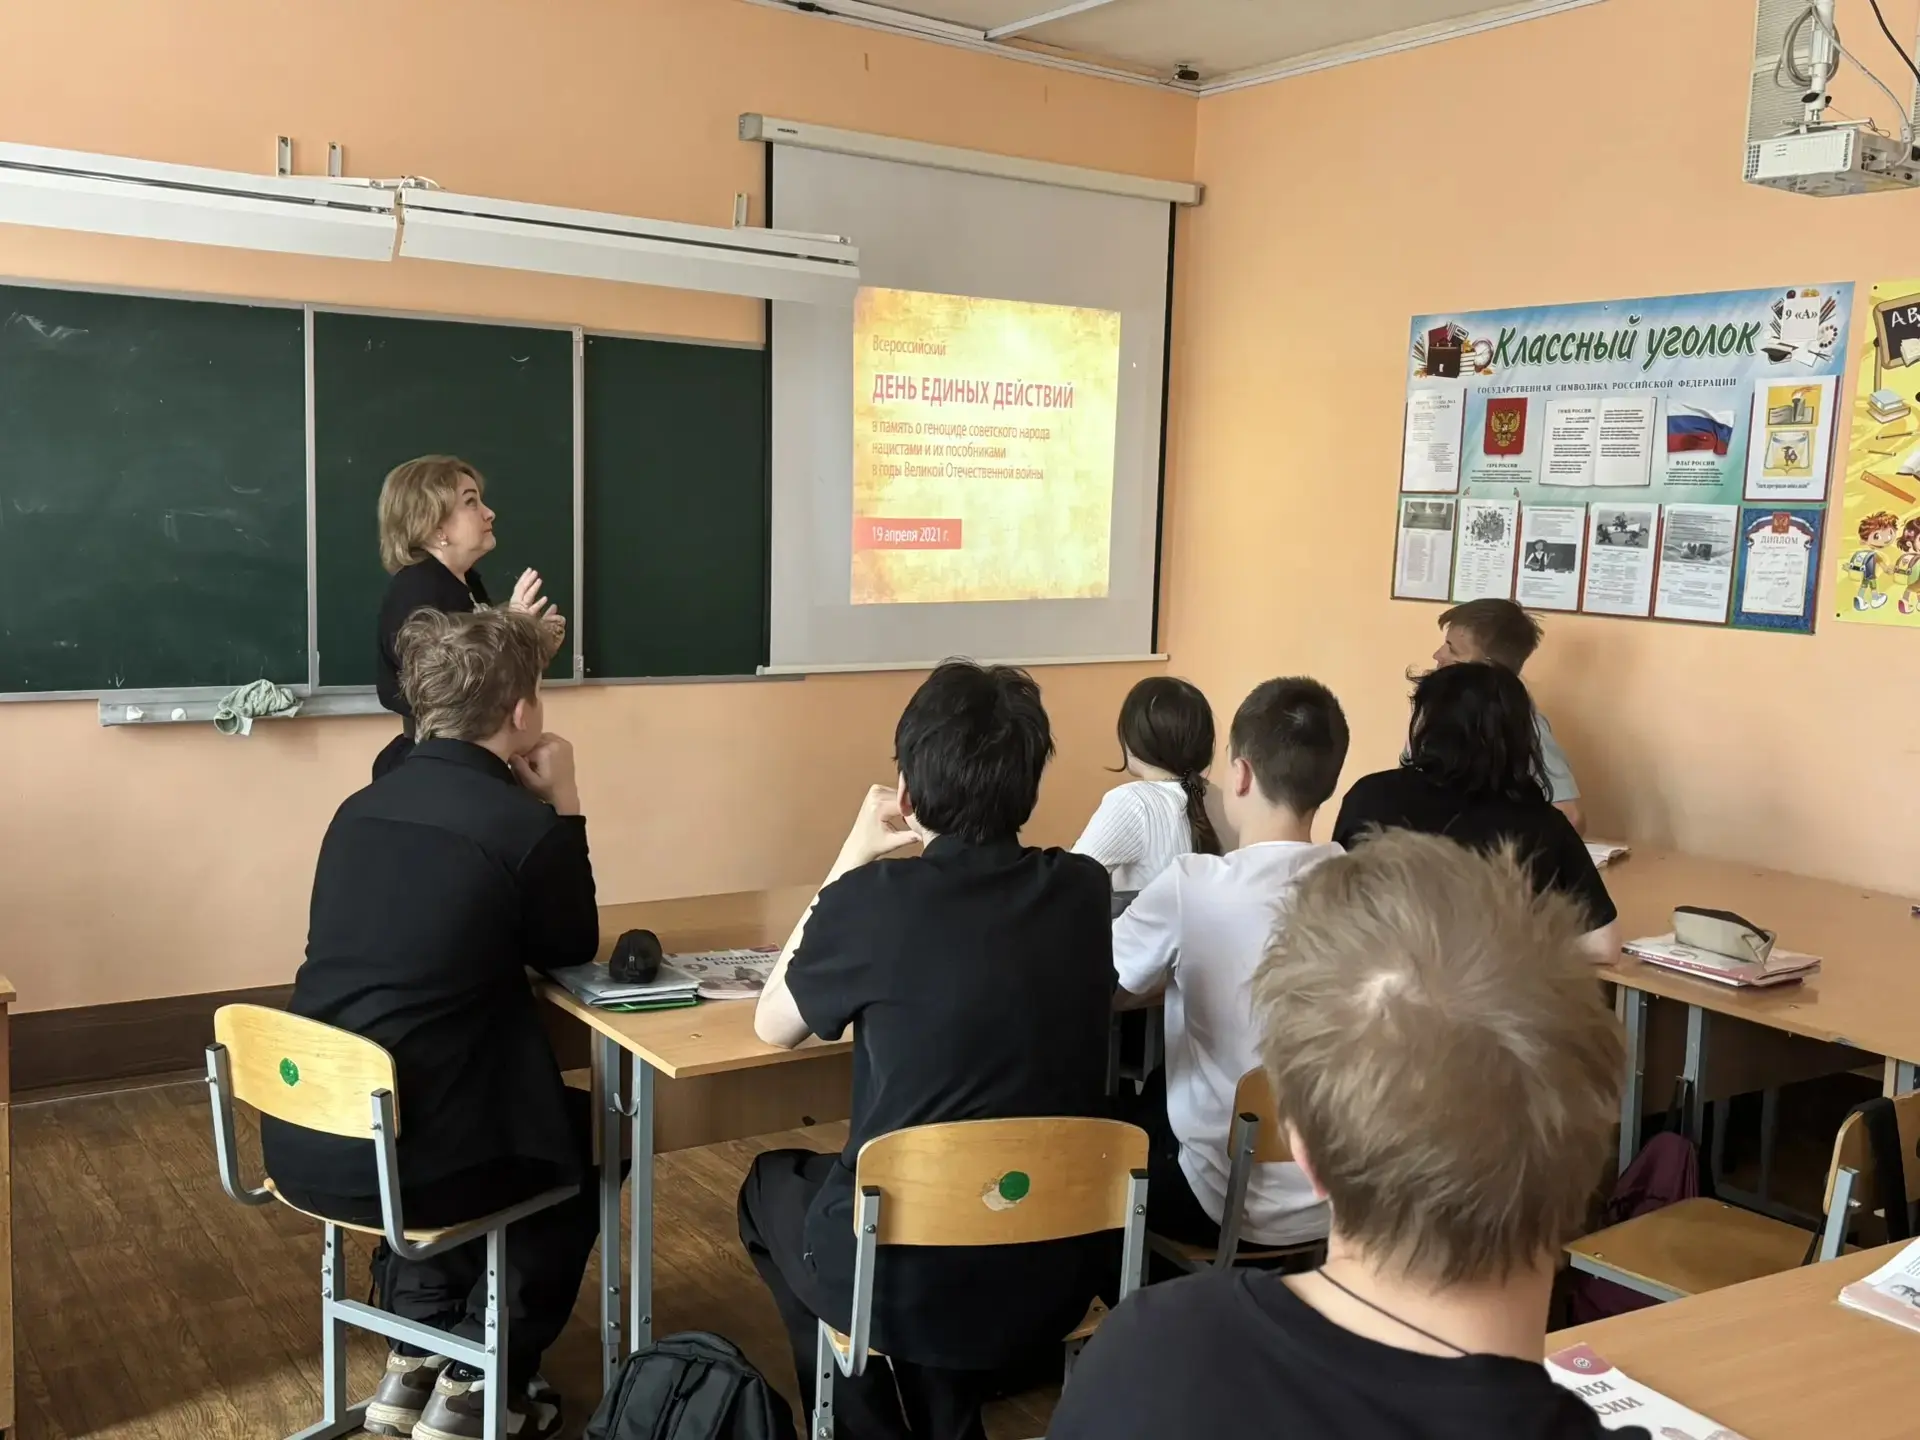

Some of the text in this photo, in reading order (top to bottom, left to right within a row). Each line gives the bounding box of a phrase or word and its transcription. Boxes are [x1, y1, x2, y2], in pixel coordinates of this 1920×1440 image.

[1785, 309, 1792, 319] 9
[873, 335, 946, 356] Всероссийский
[1492, 314, 1761, 371] Классный уголок
[873, 374, 1074, 410] ДЕНЬ ЕДИНЫХ ДЕЙСТВИЙ
[1477, 378, 1737, 394] ГОСУДАРСТВЕННАЯ СИМВОЛИКА РОССИЙСКОЙ ФЕДЕРАЦИИ
[872, 421, 1050, 441] в память о геноциде советского народа
[872, 442, 1006, 459] нацистами и их пособниками
[872, 461, 1043, 480] в годы Великой Отечественной войны
[872, 526, 950, 544] 19 апреля 2021 г.
[1760, 535, 1798, 544] ДИПЛОМ
